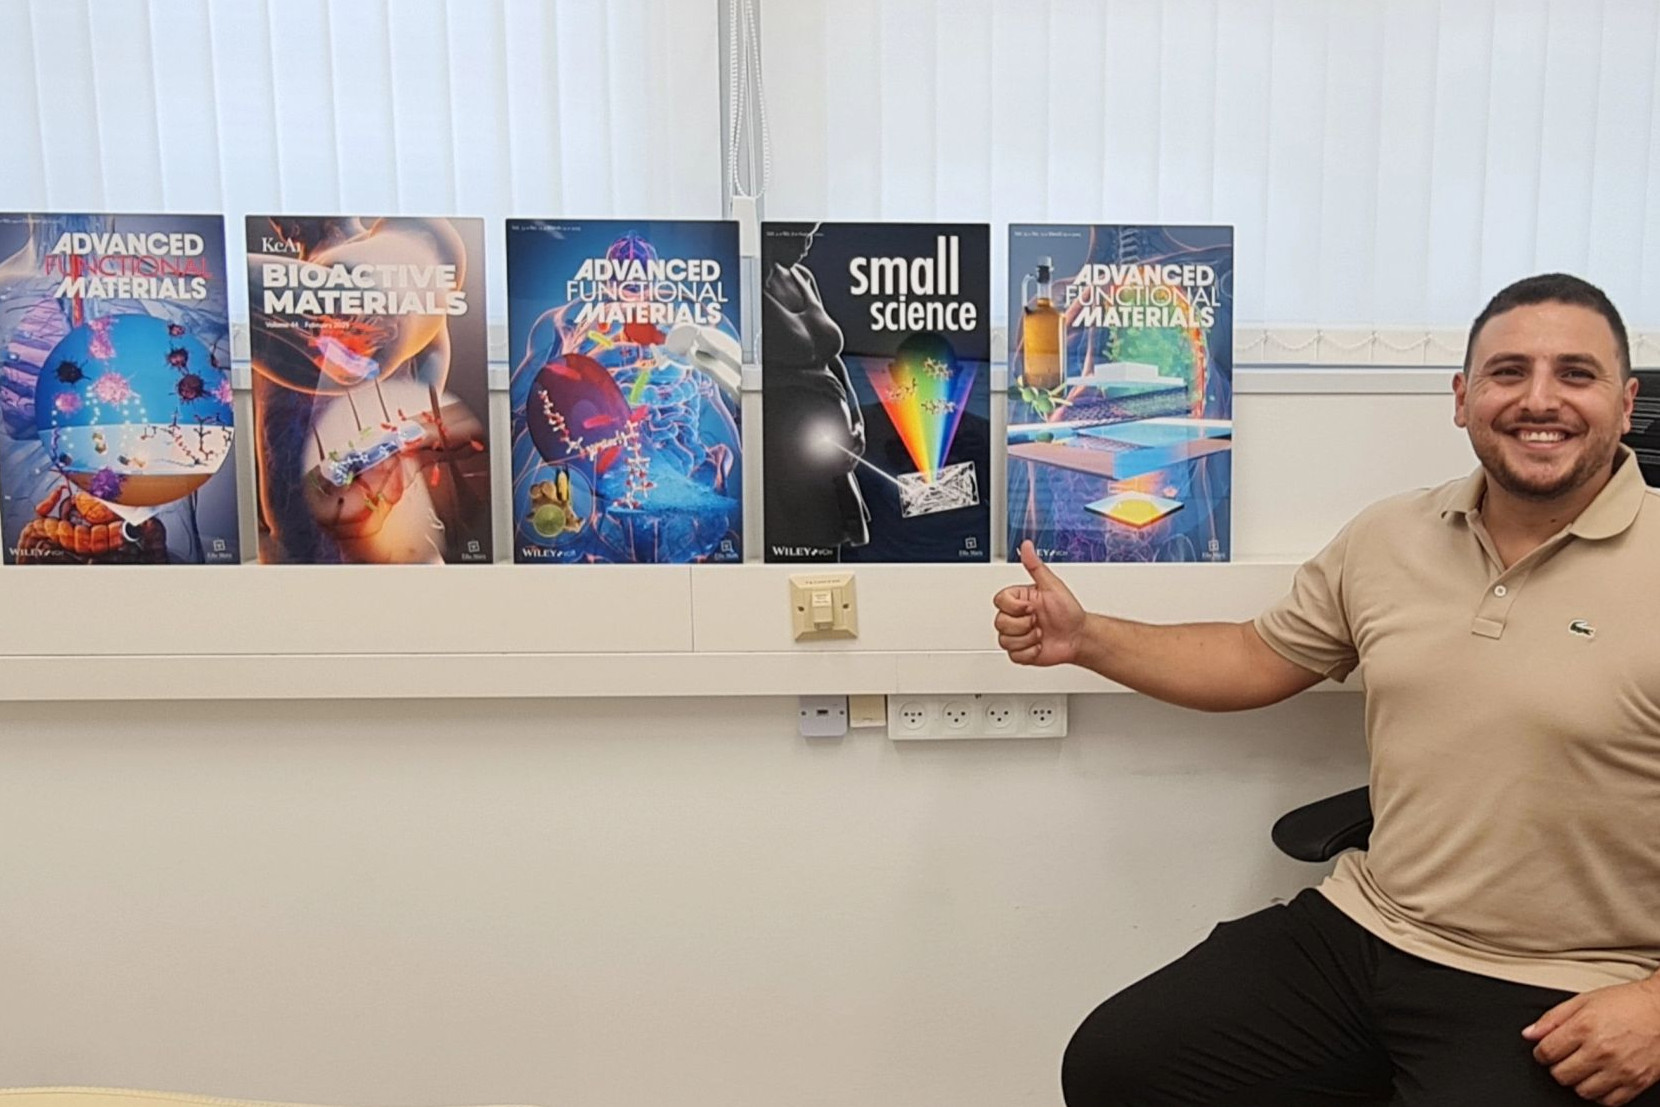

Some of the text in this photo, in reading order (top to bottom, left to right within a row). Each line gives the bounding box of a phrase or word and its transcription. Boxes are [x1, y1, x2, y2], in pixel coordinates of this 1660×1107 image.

[51, 232, 204, 256] ADVANCED
[44, 255, 213, 278] FUNCTIONAL
[262, 263, 456, 288] BIOACTIVE
[574, 259, 721, 281] ADVANCED
[850, 235, 959, 295] small
[1073, 264, 1214, 286] ADVANCED
[53, 275, 207, 299] MATERIALS
[567, 281, 729, 303] FUNCTIONAL
[1065, 285, 1221, 307] FUNCTIONAL
[263, 290, 468, 315] MATERIALS
[574, 302, 722, 324] MATERIALS
[870, 295, 977, 330] science
[1072, 307, 1215, 328] MATERIALS
[8, 547, 43, 556] WILEY
[522, 548, 557, 557] WILEY
[772, 546, 811, 556] WILEY
